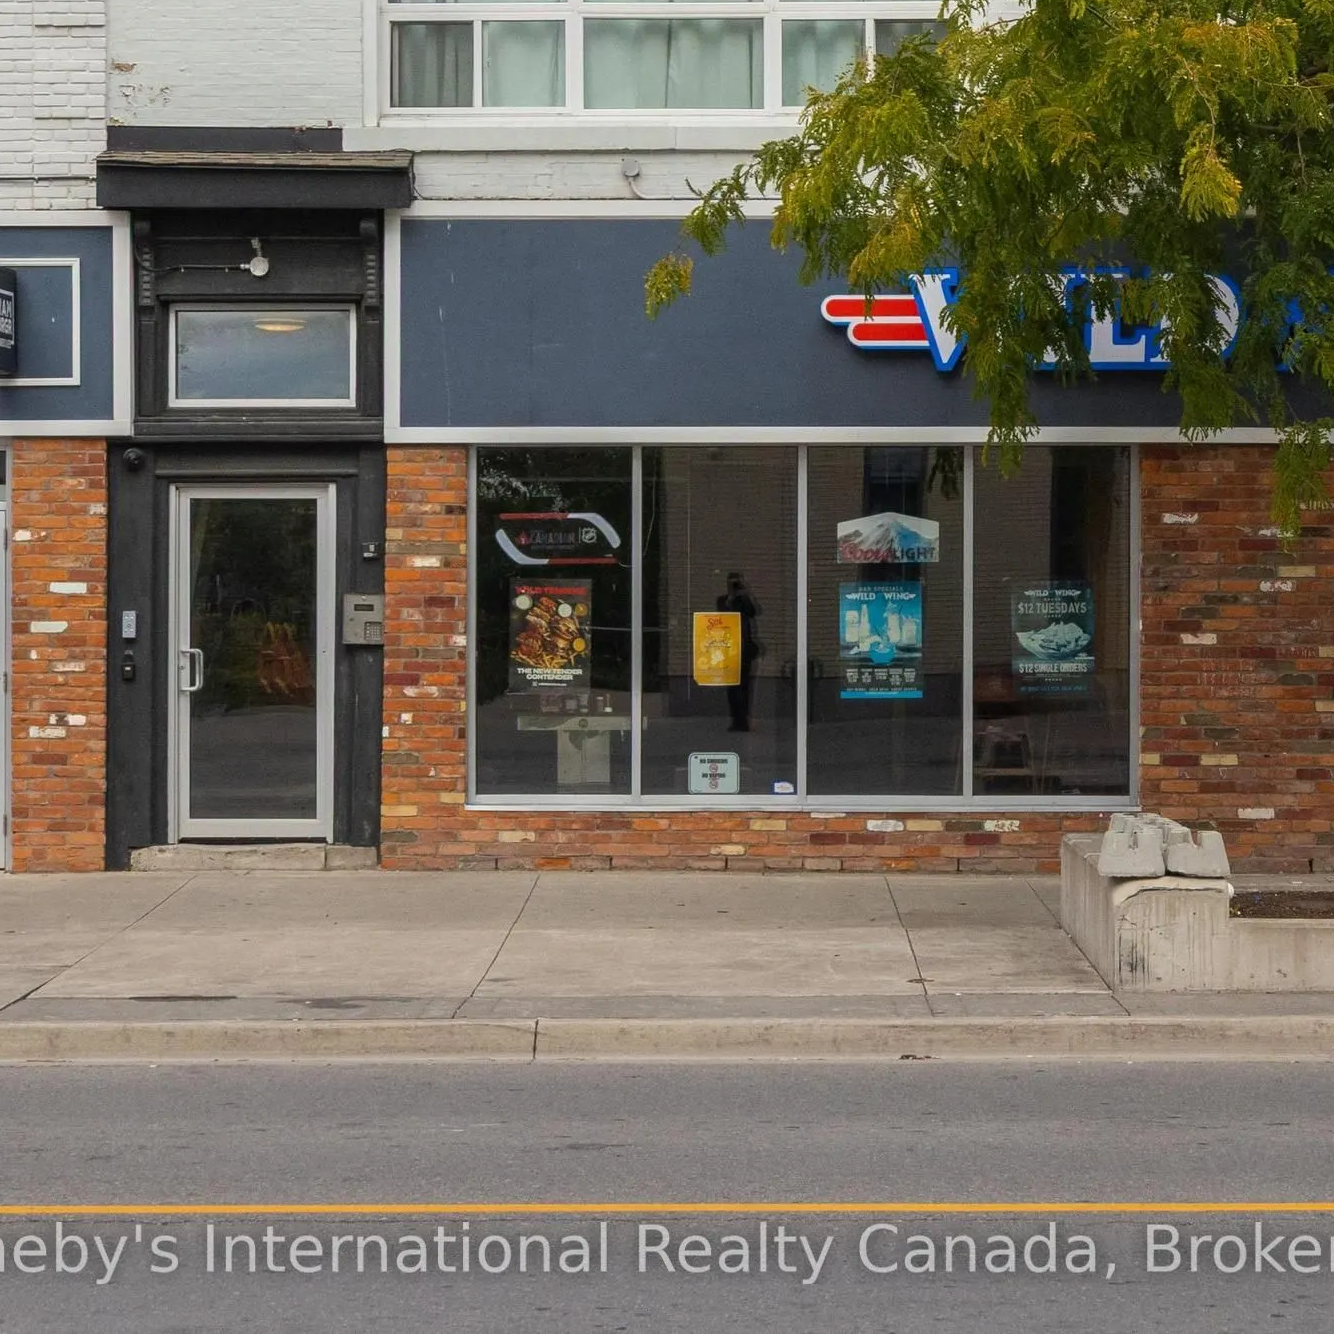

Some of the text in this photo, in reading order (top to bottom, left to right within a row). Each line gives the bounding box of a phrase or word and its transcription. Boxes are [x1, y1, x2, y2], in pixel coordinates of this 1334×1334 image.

[894, 547, 936, 561] LIGHT
[851, 592, 910, 600] WILD WING
[1018, 601, 1087, 614] $12 TUESDAYS
[1019, 663, 1088, 674] $12 SINGLE ORDERS
